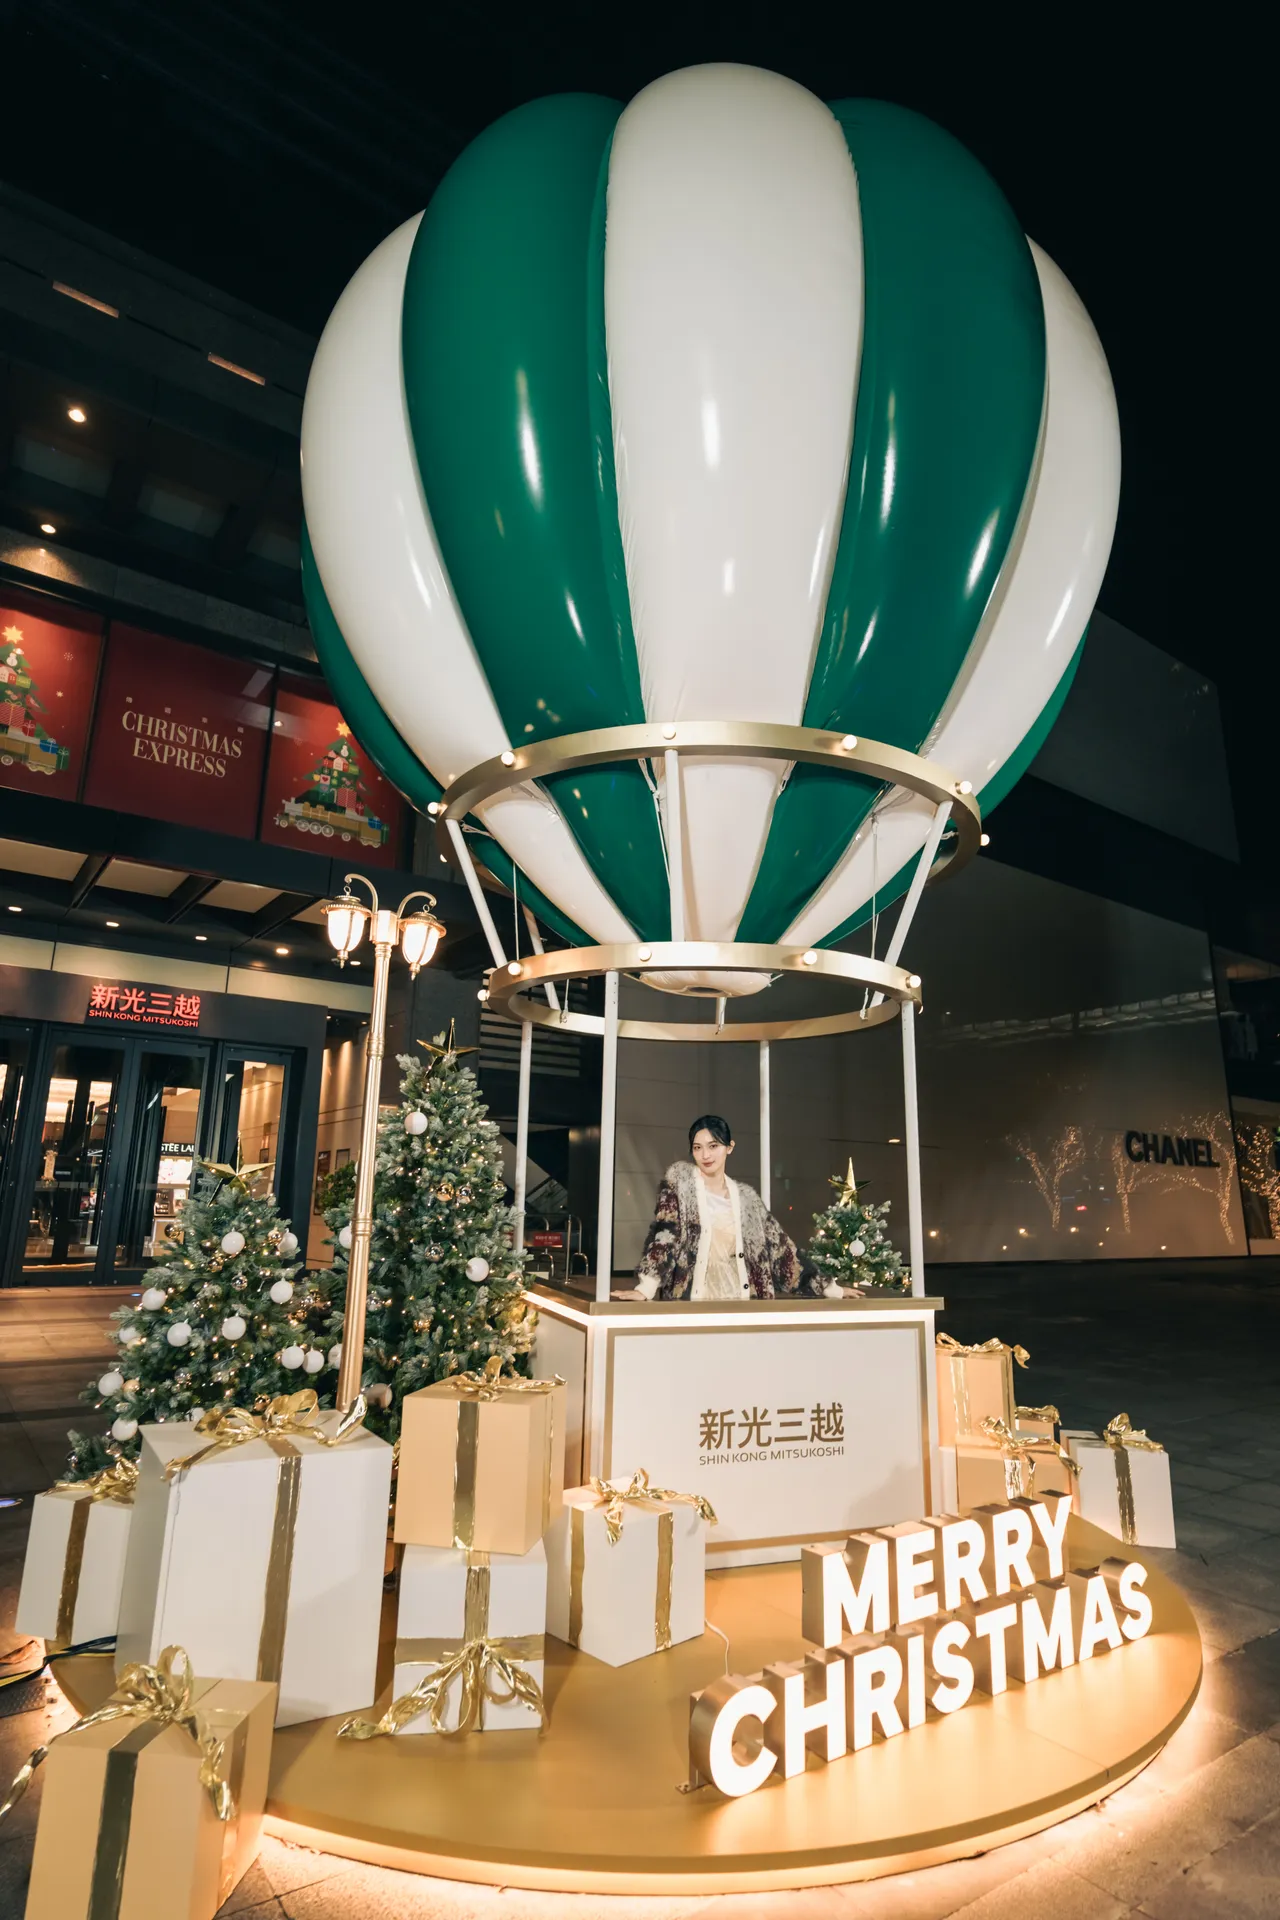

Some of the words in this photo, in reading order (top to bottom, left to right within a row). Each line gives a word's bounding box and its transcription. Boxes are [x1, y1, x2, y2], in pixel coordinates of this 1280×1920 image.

[122, 710, 243, 759] CHRISTMAS
[132, 736, 227, 778] EXPRESS
[88, 1008, 113, 1018] SHIN
[113, 1011, 141, 1022] KONG
[142, 1015, 199, 1028] MITSUKOSHI
[89, 983, 201, 1020] 新光三越
[1124, 1129, 1221, 1168] CHANEL
[698, 1401, 845, 1451] 新光三越
[698, 1454, 730, 1466] SHIN
[731, 1450, 768, 1464] KONG
[770, 1446, 845, 1460] MITSUKOSHI
[822, 1495, 1073, 1648] MERRY
[709, 1562, 1153, 1797] CHRISTMAS
